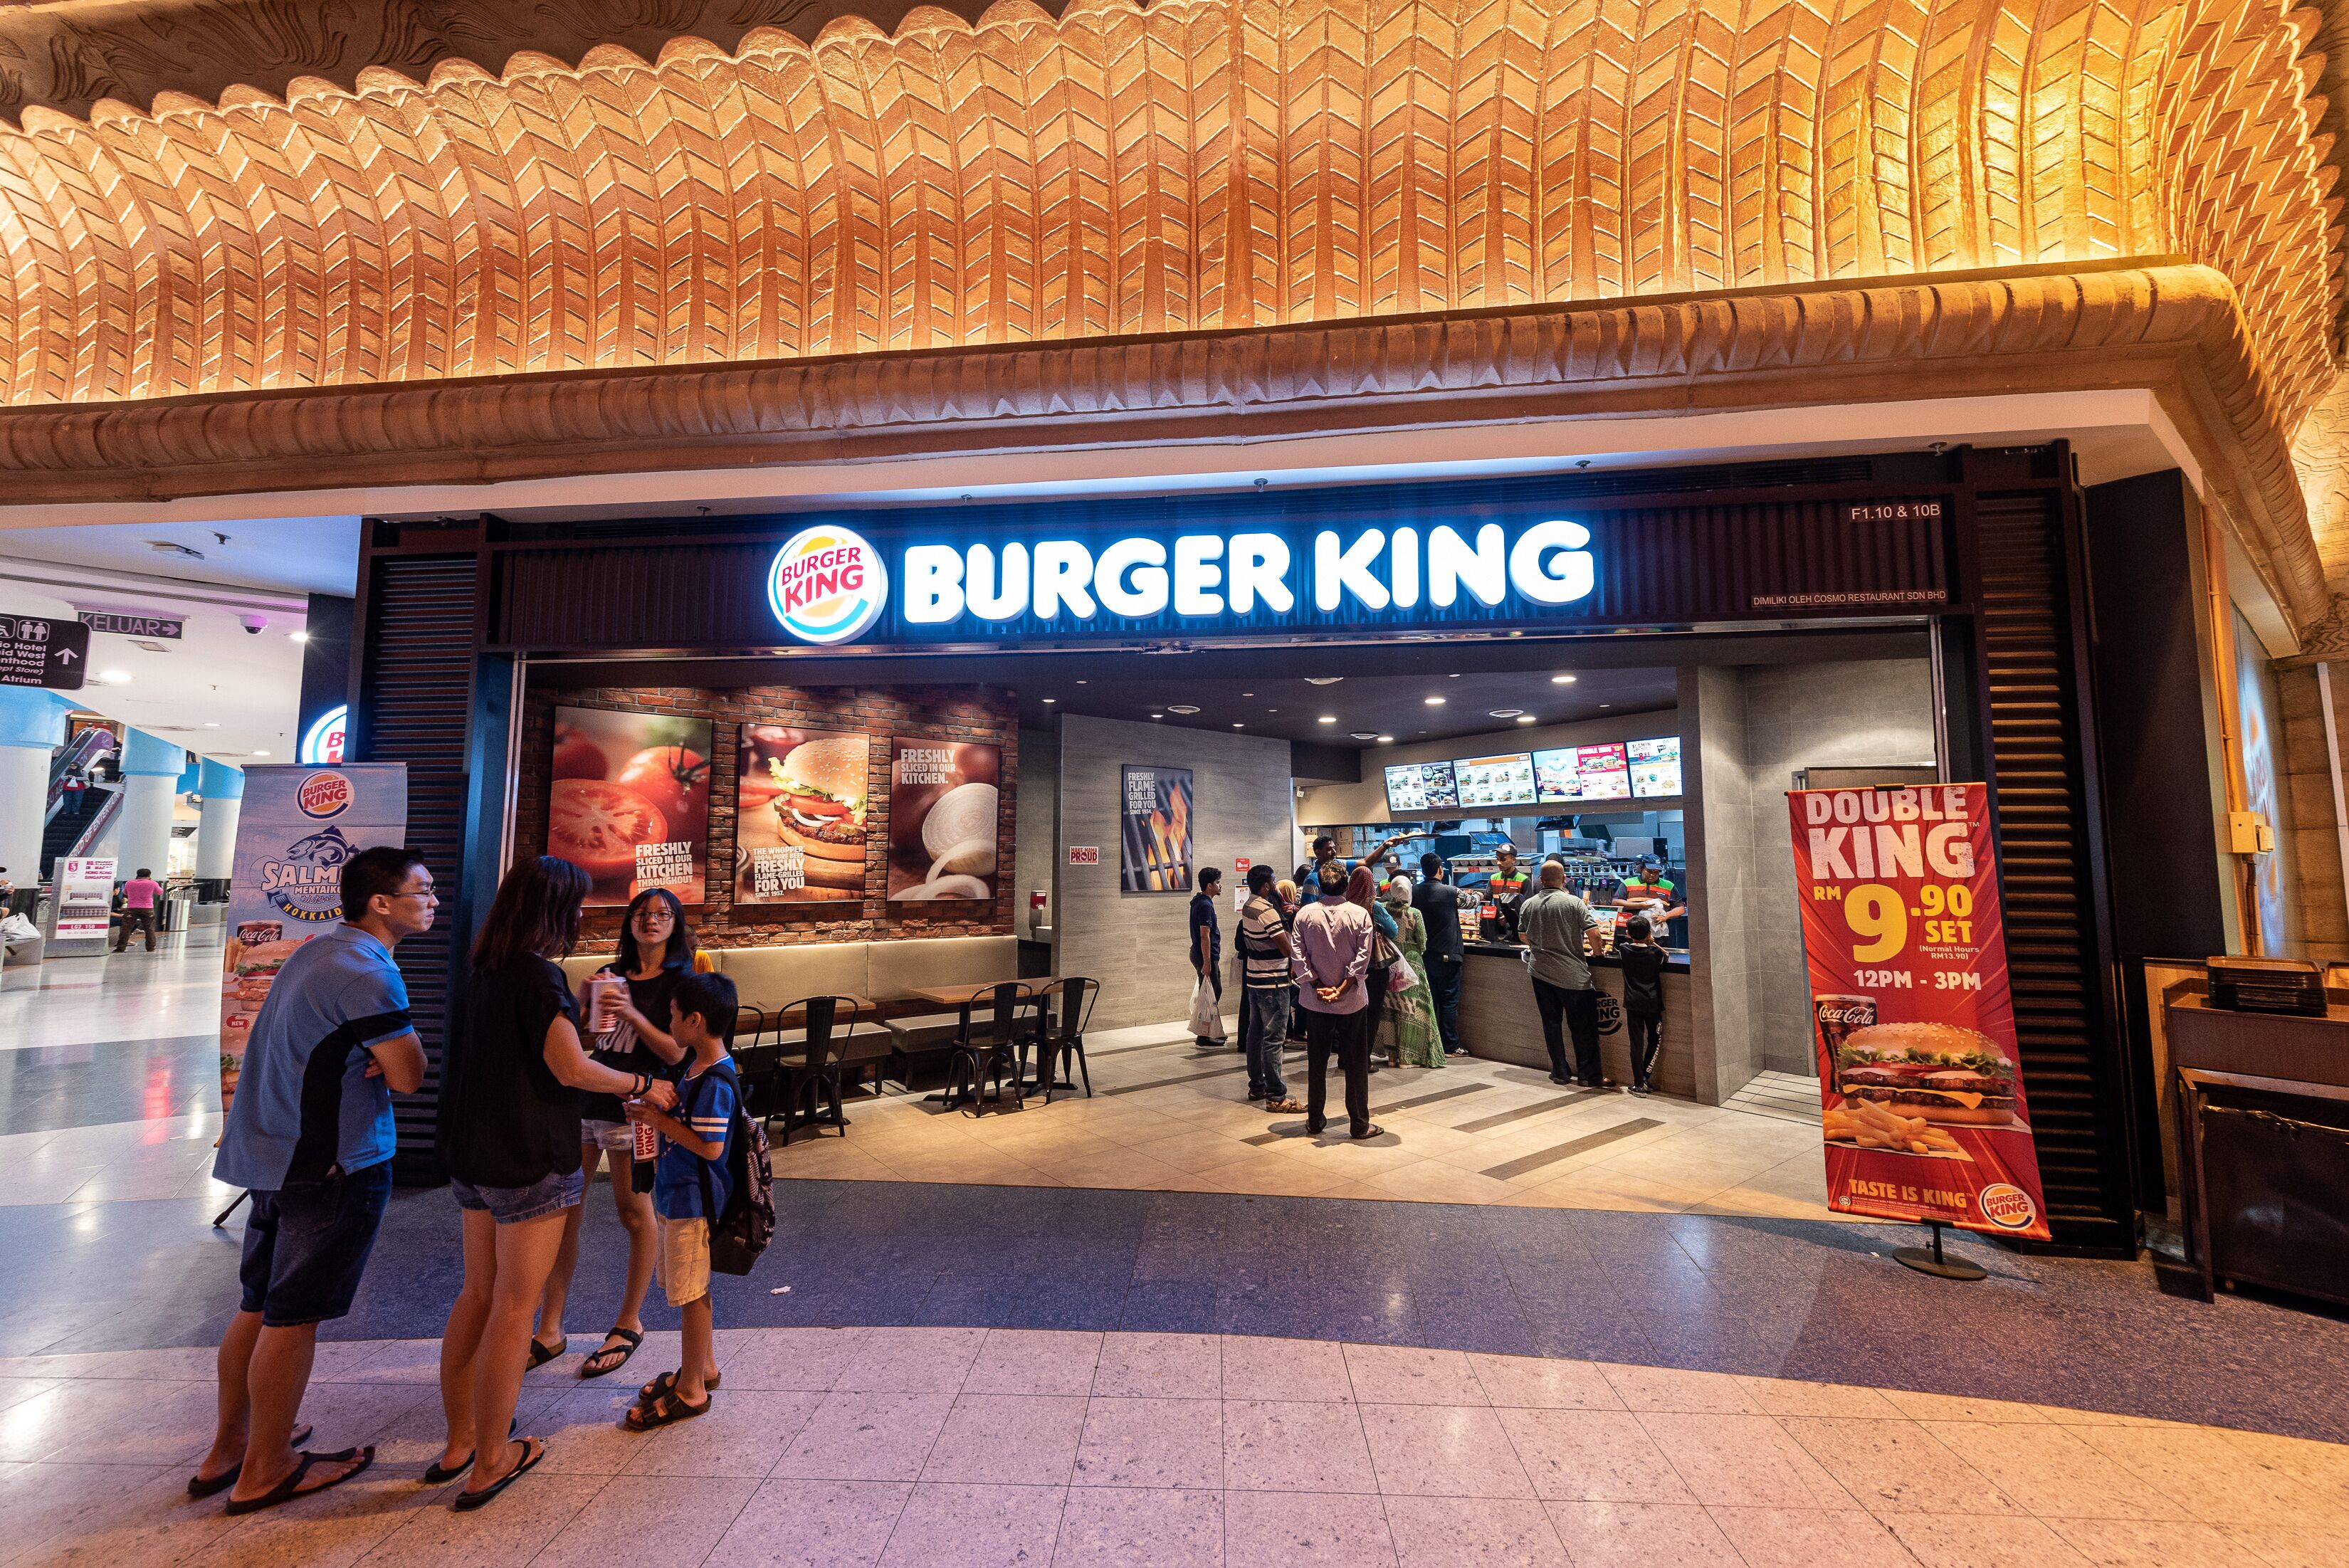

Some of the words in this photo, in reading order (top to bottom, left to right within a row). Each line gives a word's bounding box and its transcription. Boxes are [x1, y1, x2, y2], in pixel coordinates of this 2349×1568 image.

[1851, 506, 1892, 520] F1.10
[1897, 505, 1908, 517] &
[1912, 504, 1940, 517] 10B
[782, 547, 861, 586] BURGER
[905, 533, 1294, 623] BURGER
[1315, 520, 1594, 614] KING
[785, 564, 864, 614] KING
[1753, 596, 1787, 605] DIMILIKI
[1789, 595, 1812, 604] OLEH
[1814, 594, 1846, 604] COSMO
[1848, 592, 1905, 602] RESTAURANT
[1906, 591, 1926, 601] SDN
[1928, 591, 1947, 599] BHD
[80, 613, 160, 636] KELUAR
[14, 642, 46, 651] Hotel
[17, 650, 46, 659] West
[15, 666, 43, 675] Store)
[1, 675, 42, 684] Atrium
[900, 749, 956, 763] FRESHLY
[901, 763, 928, 772] SLICED
[929, 764, 938, 772] IN
[939, 763, 956, 772] OUR
[901, 773, 949, 784] KITCHEN.
[1128, 772, 1155, 781] FRESHLY
[303, 779, 347, 798] BURGER
[1128, 781, 1155, 791] FLAME
[303, 787, 348, 810] KING
[1128, 791, 1156, 800] GRILLED
[1129, 801, 1143, 809] FOR
[1144, 800, 1157, 809] YOU
[1805, 786, 1969, 825] DOUBLE
[636, 841, 692, 858] FRESHLY
[1071, 852, 1098, 861] PROUD
[1808, 822, 1975, 880] KING
[636, 856, 663, 866] SLICED
[664, 855, 673, 863] IN
[675, 854, 693, 863] OUR
[755, 858, 805, 873] FRESHLY
[261, 861, 342, 891] SALM
[636, 863, 693, 879] KITCHEN
[755, 870, 804, 880] FLAME-GRILLED
[637, 875, 693, 888] THROUGHOUT
[755, 879, 779, 893] FOR
[780, 876, 805, 890] YOU
[1814, 886, 1841, 900] RM
[283, 902, 342, 921] HOKKAID
[239, 927, 280, 942] Coca-Cola
[1925, 920, 1972, 943] SET
[1853, 970, 1913, 989] 12PM
[1933, 972, 1982, 991] 3PM
[1596, 998, 1618, 1008] RGER
[1597, 1006, 1620, 1021] ING
[1819, 1004, 1874, 1025] Coca-Cola
[635, 1121, 645, 1157] BURGE
[643, 1127, 655, 1155] KING
[1849, 1179, 1897, 1199] TASTE
[1901, 1185, 1918, 1202] IS
[1923, 1189, 1967, 1209] KING
[1986, 1194, 2025, 1207] BURGER
[1989, 1201, 2029, 1219] KING
